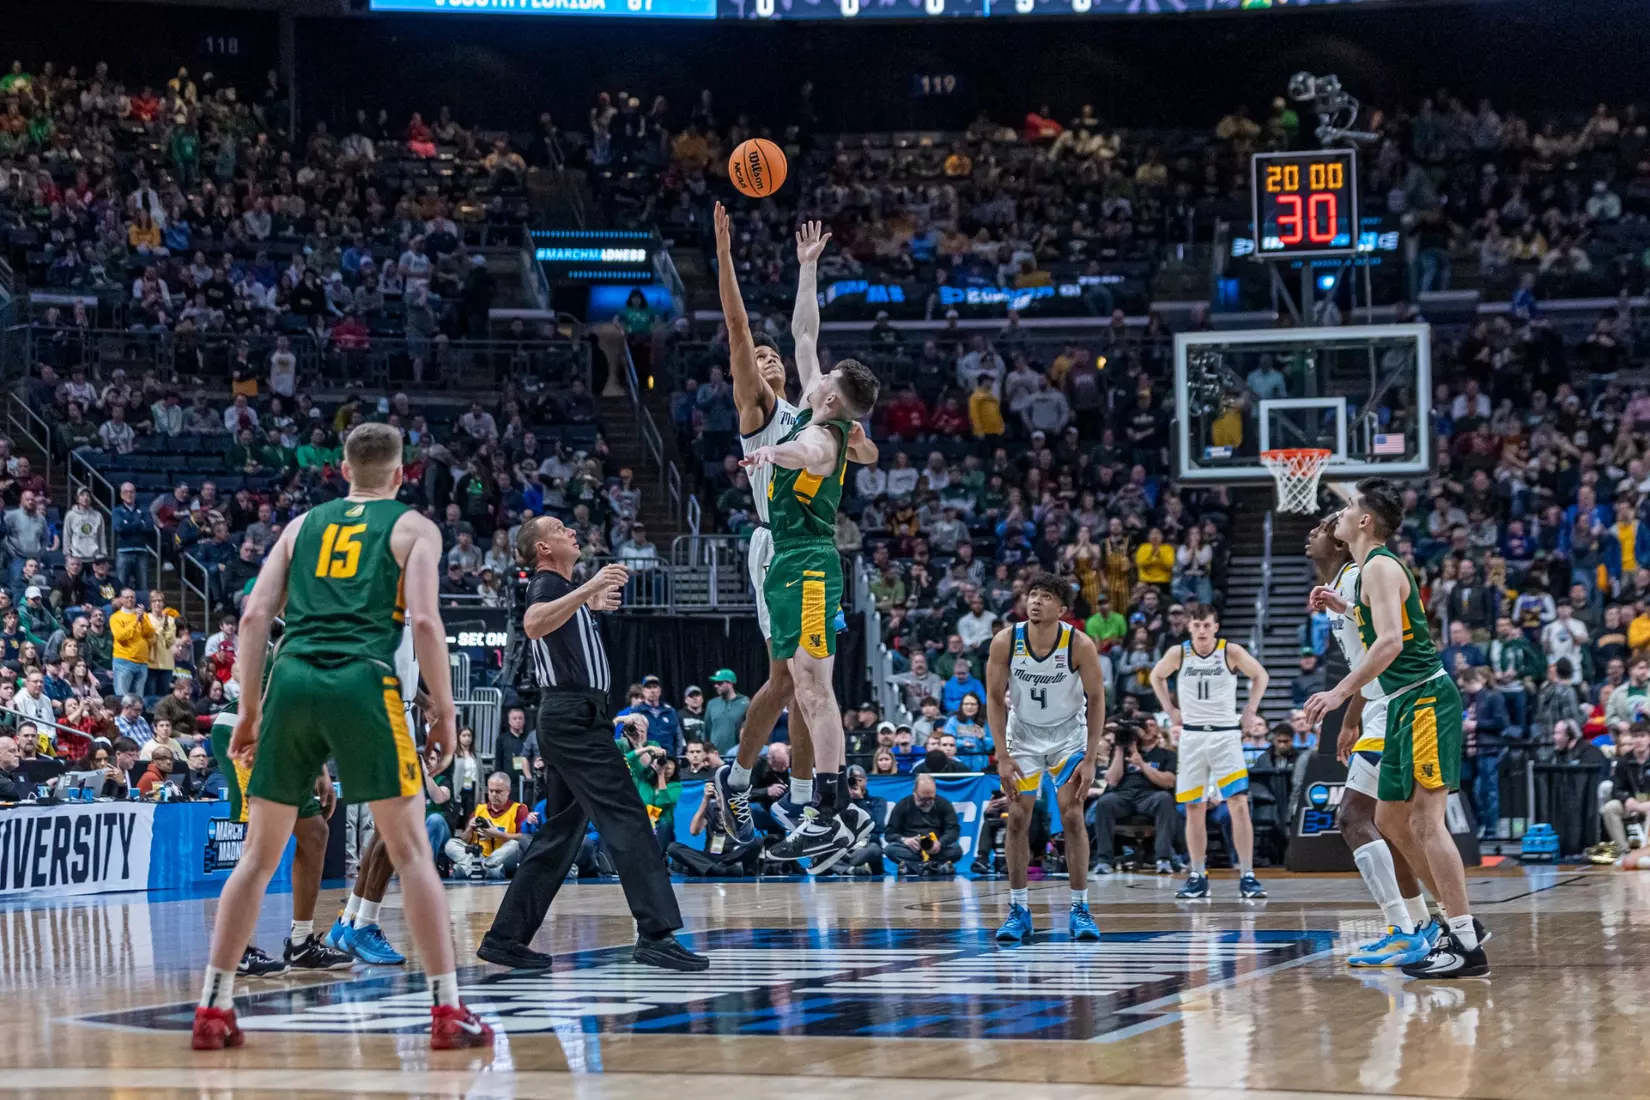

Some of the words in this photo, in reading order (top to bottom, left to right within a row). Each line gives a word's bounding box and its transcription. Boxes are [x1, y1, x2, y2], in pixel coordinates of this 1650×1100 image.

[749, 151, 764, 189] Wilson
[1276, 192, 1337, 245] 30
[315, 522, 368, 579] 15
[1013, 667, 1067, 686] Marquette
[1184, 666, 1225, 680] Marquette
[1030, 687, 1048, 710] 4
[1197, 681, 1209, 700] 11
[215, 820, 244, 841] MARCH
[0, 812, 137, 891] IVERSITY
